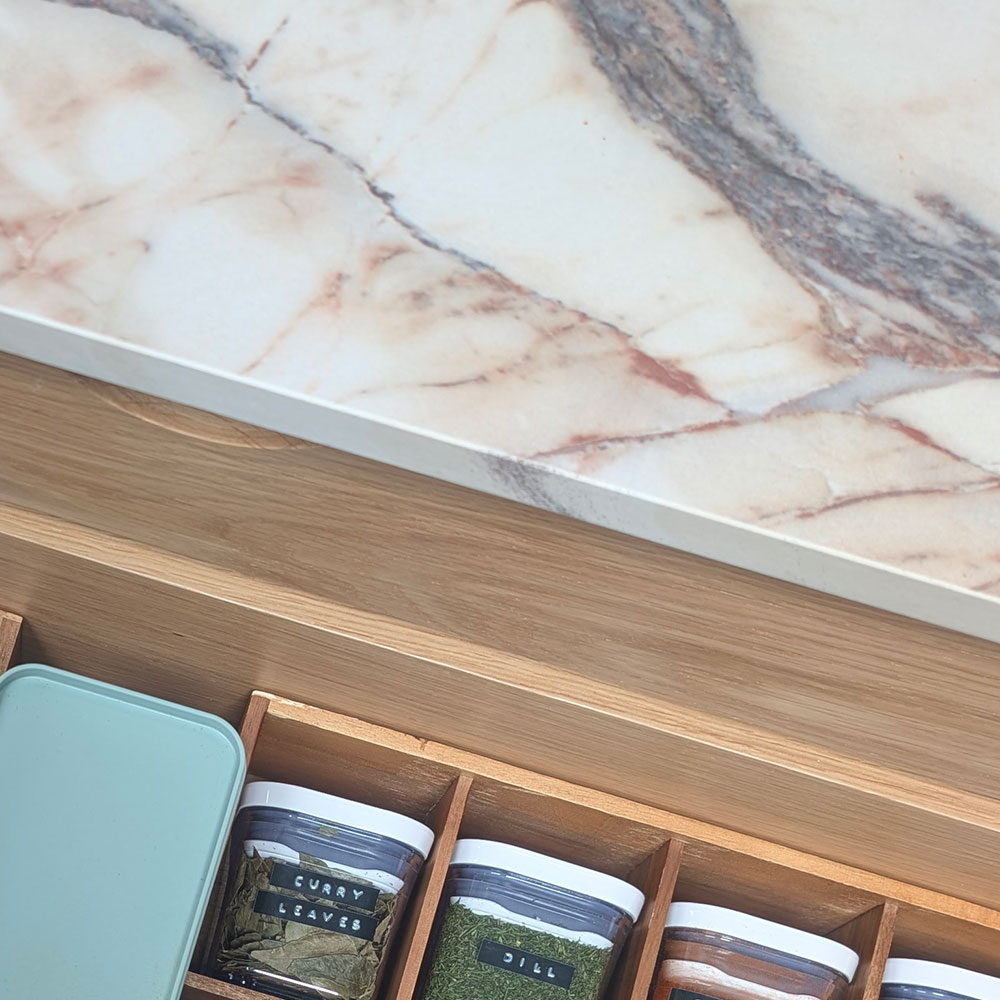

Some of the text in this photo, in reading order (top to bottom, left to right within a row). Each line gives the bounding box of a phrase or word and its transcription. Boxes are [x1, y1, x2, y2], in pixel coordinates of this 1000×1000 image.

[294, 874, 365, 901] CURRY
[278, 902, 362, 931] LEAVES
[503, 952, 556, 979] DILL
